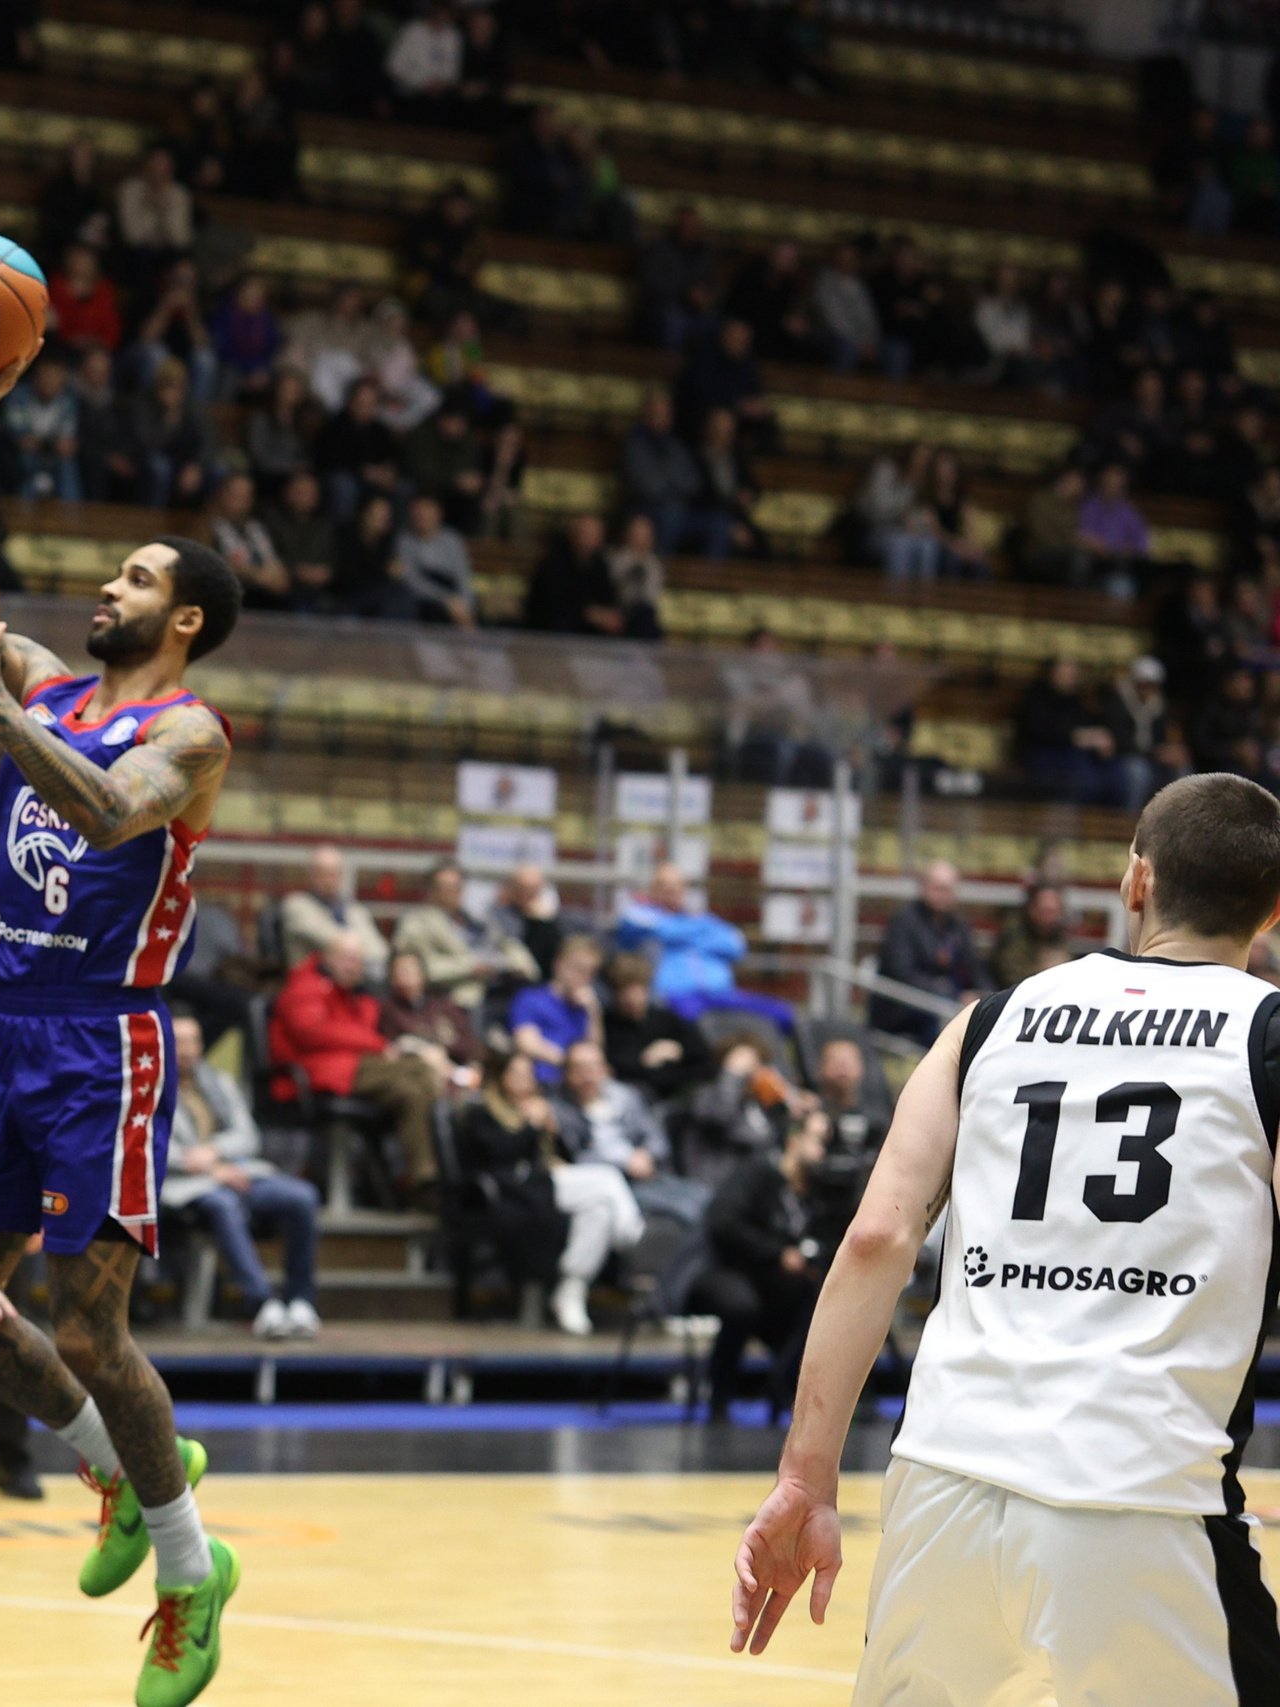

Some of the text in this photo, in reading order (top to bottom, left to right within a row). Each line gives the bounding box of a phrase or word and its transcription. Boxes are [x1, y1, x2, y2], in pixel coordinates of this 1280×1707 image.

[21, 800, 70, 831] CSK
[45, 865, 70, 915] 6
[1015, 1004, 1229, 1047] VOLKHIN
[1011, 1081, 1182, 1223] 13
